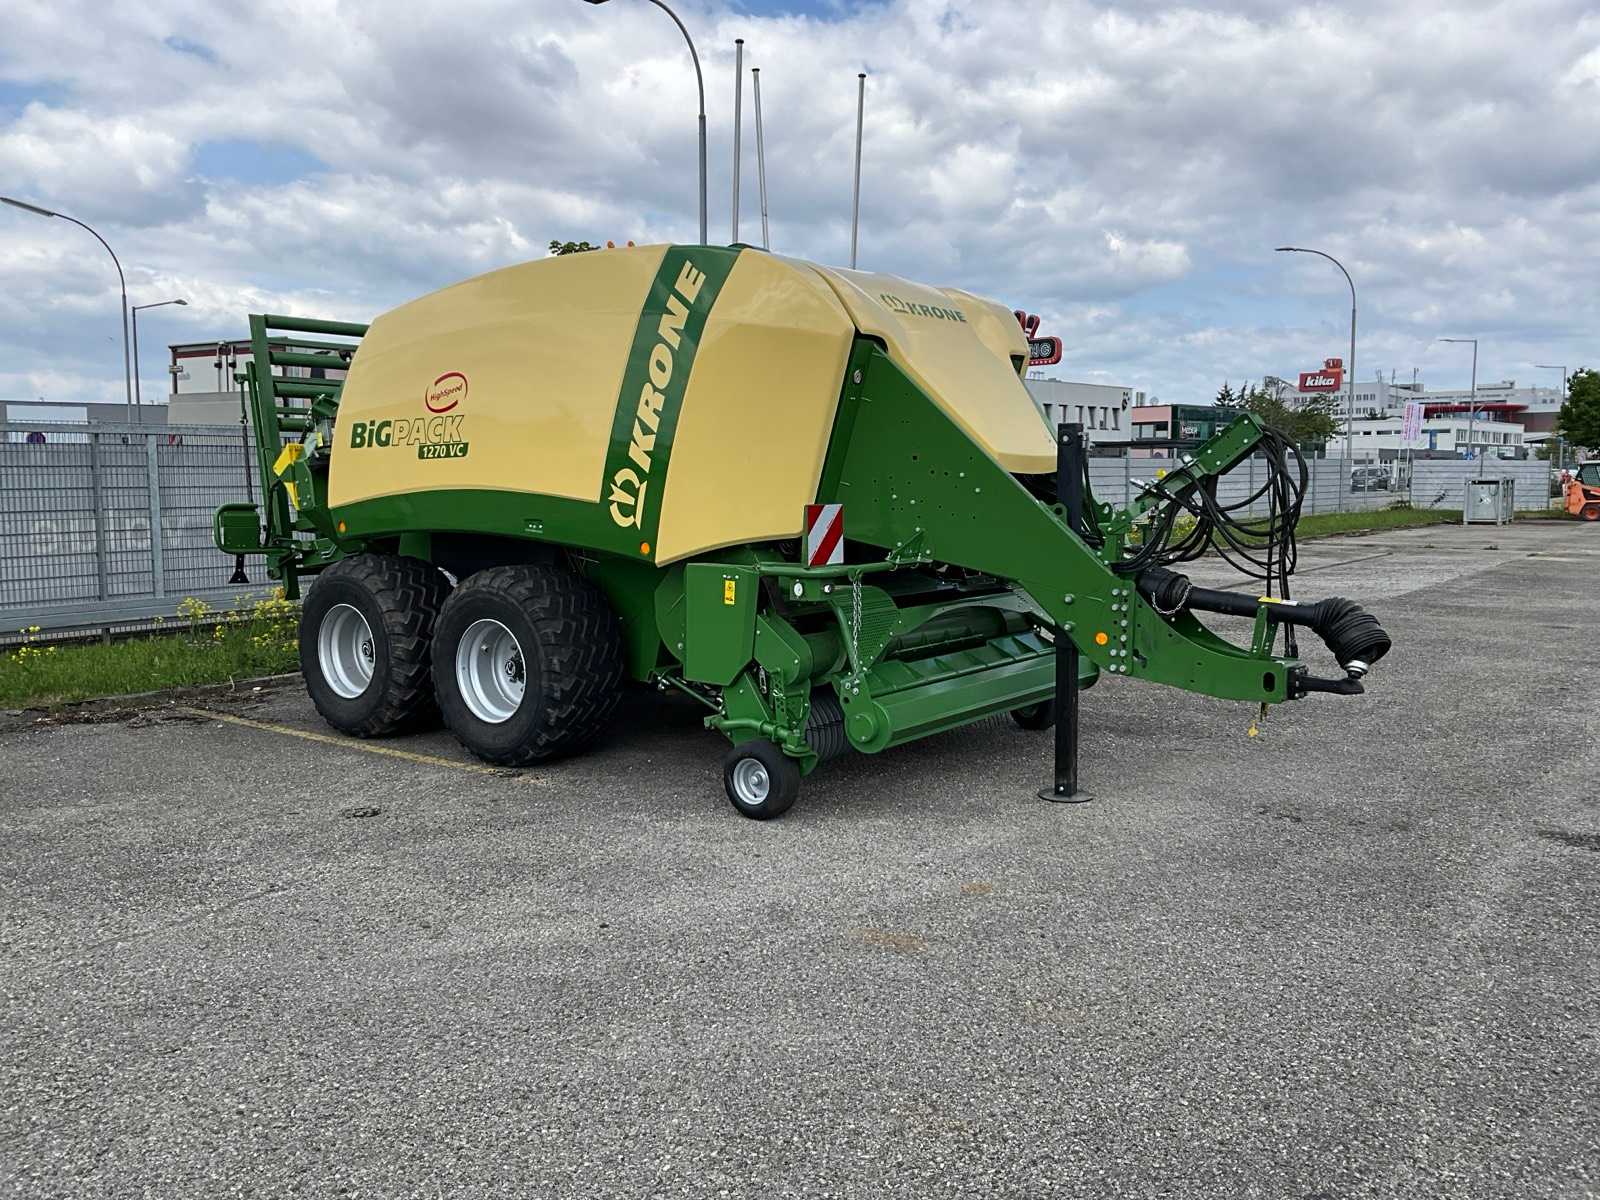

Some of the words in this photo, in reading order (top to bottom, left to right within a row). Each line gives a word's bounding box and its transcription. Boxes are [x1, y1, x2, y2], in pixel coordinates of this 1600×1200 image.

[905, 302, 966, 323] KRONE
[628, 259, 706, 474] KRONE
[1305, 376, 1335, 387] kika
[430, 383, 463, 401] HighSpeed
[423, 446, 447, 458] 1270
[449, 444, 464, 457] VC
